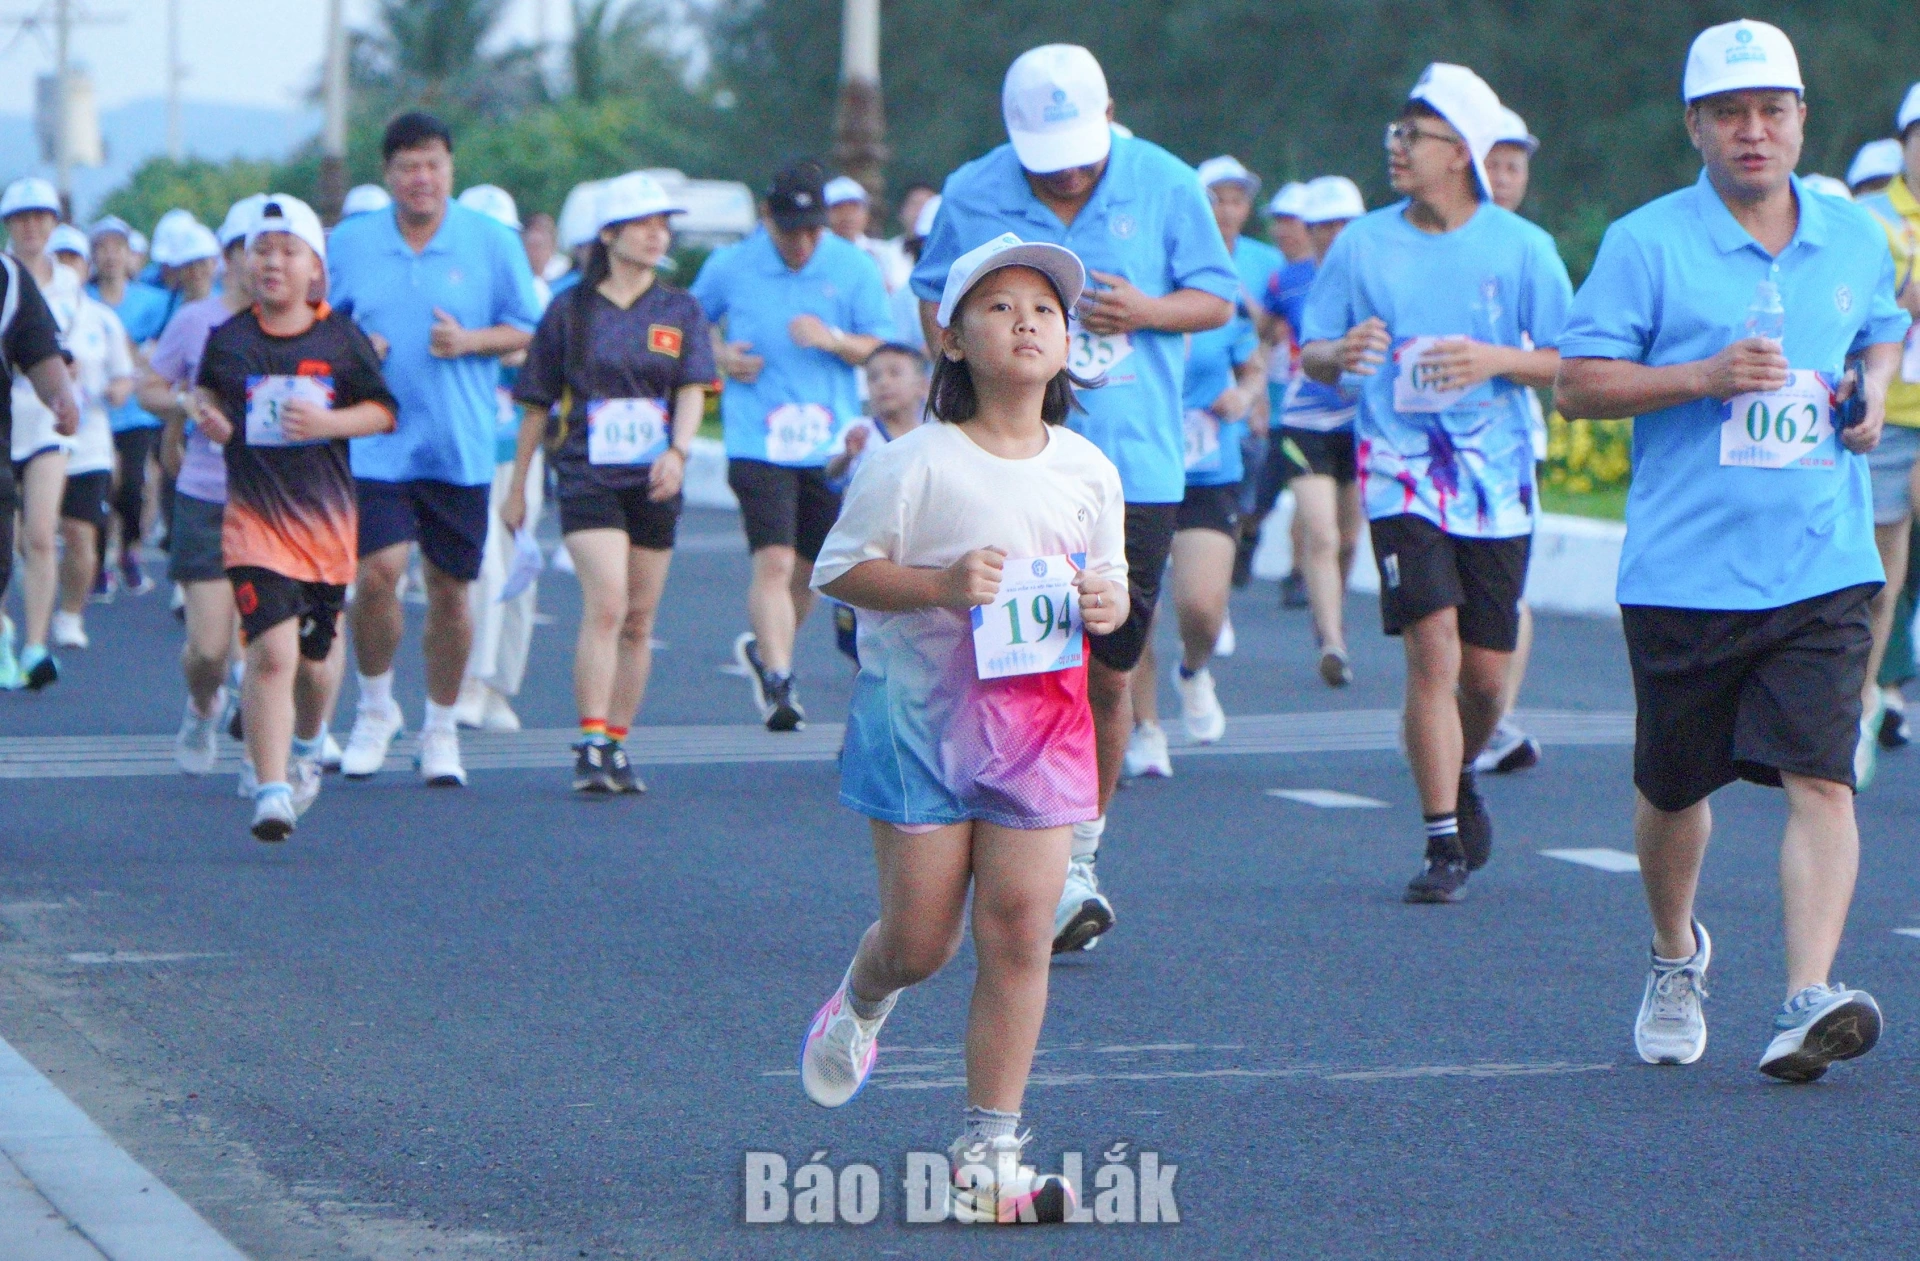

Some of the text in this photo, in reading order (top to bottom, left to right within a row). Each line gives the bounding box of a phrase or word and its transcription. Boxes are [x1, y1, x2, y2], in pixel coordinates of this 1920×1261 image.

[604, 420, 654, 445] 049
[1745, 399, 1819, 444] 062
[1001, 591, 1072, 647] 194
